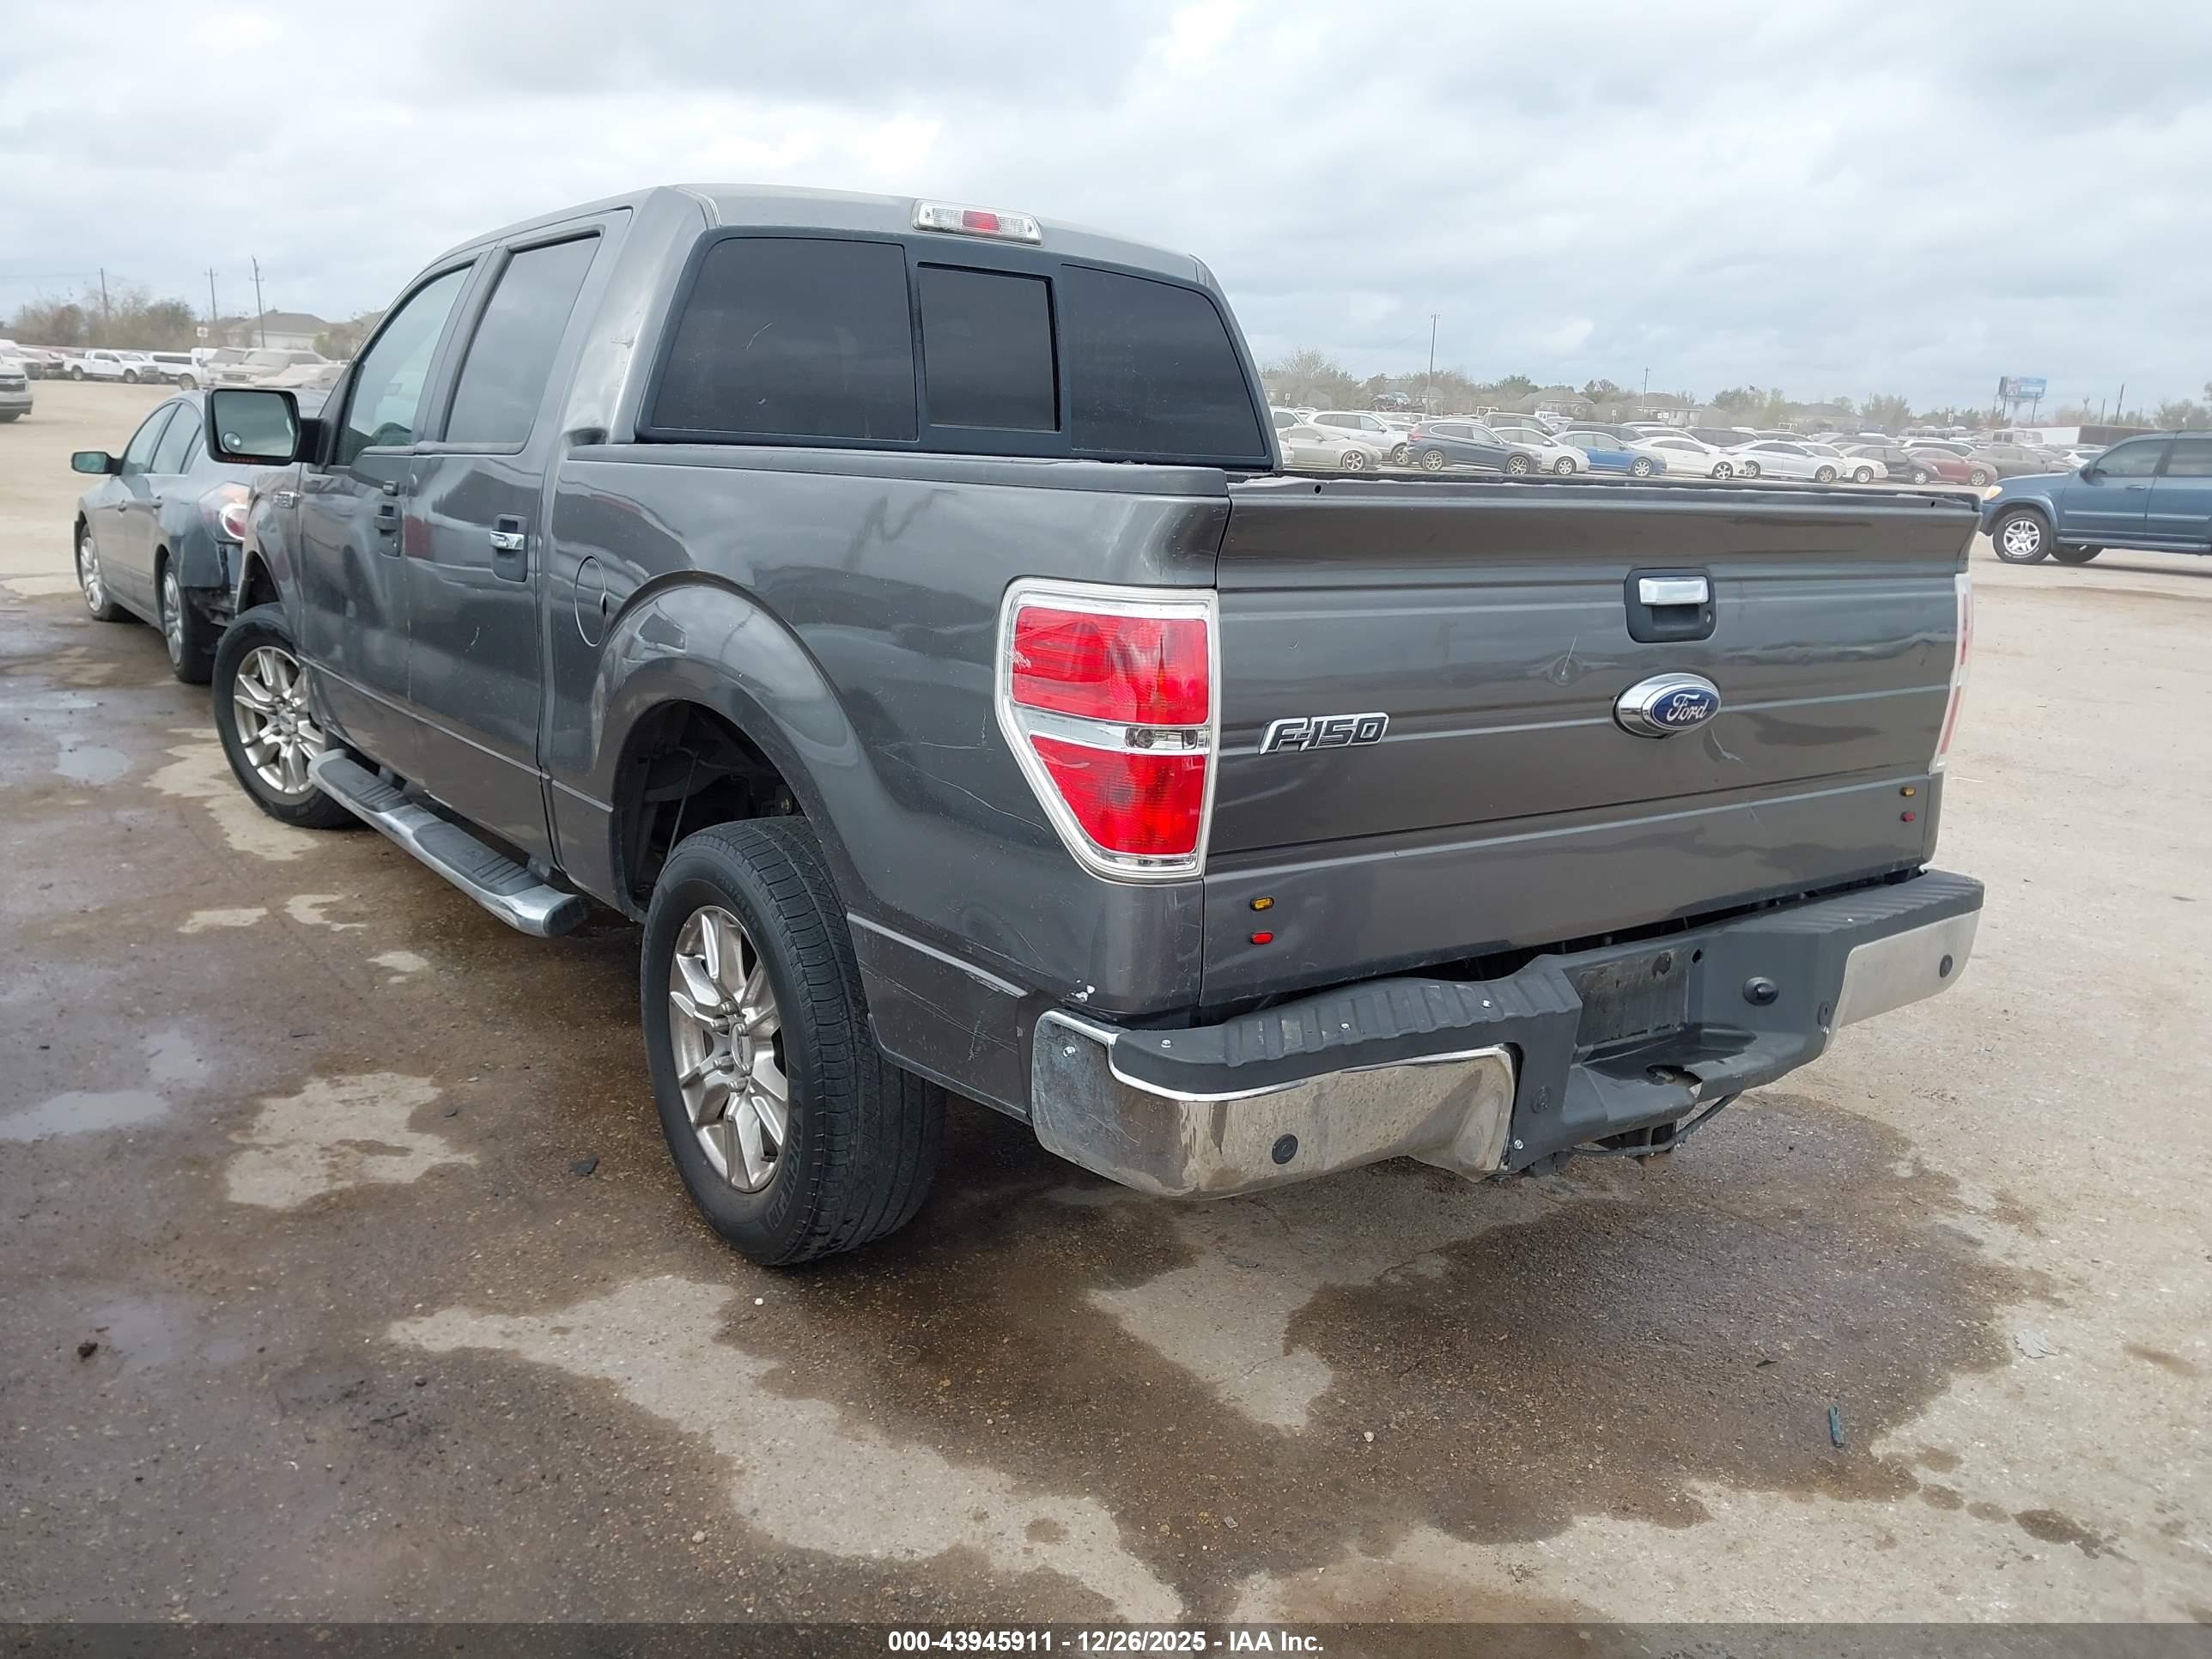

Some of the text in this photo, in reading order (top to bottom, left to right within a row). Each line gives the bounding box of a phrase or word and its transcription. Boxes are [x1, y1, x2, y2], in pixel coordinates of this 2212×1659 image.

[1666, 693, 1710, 722] Ford
[1259, 712, 1389, 755] F-150
[767, 1115, 803, 1231] MICHELIN
